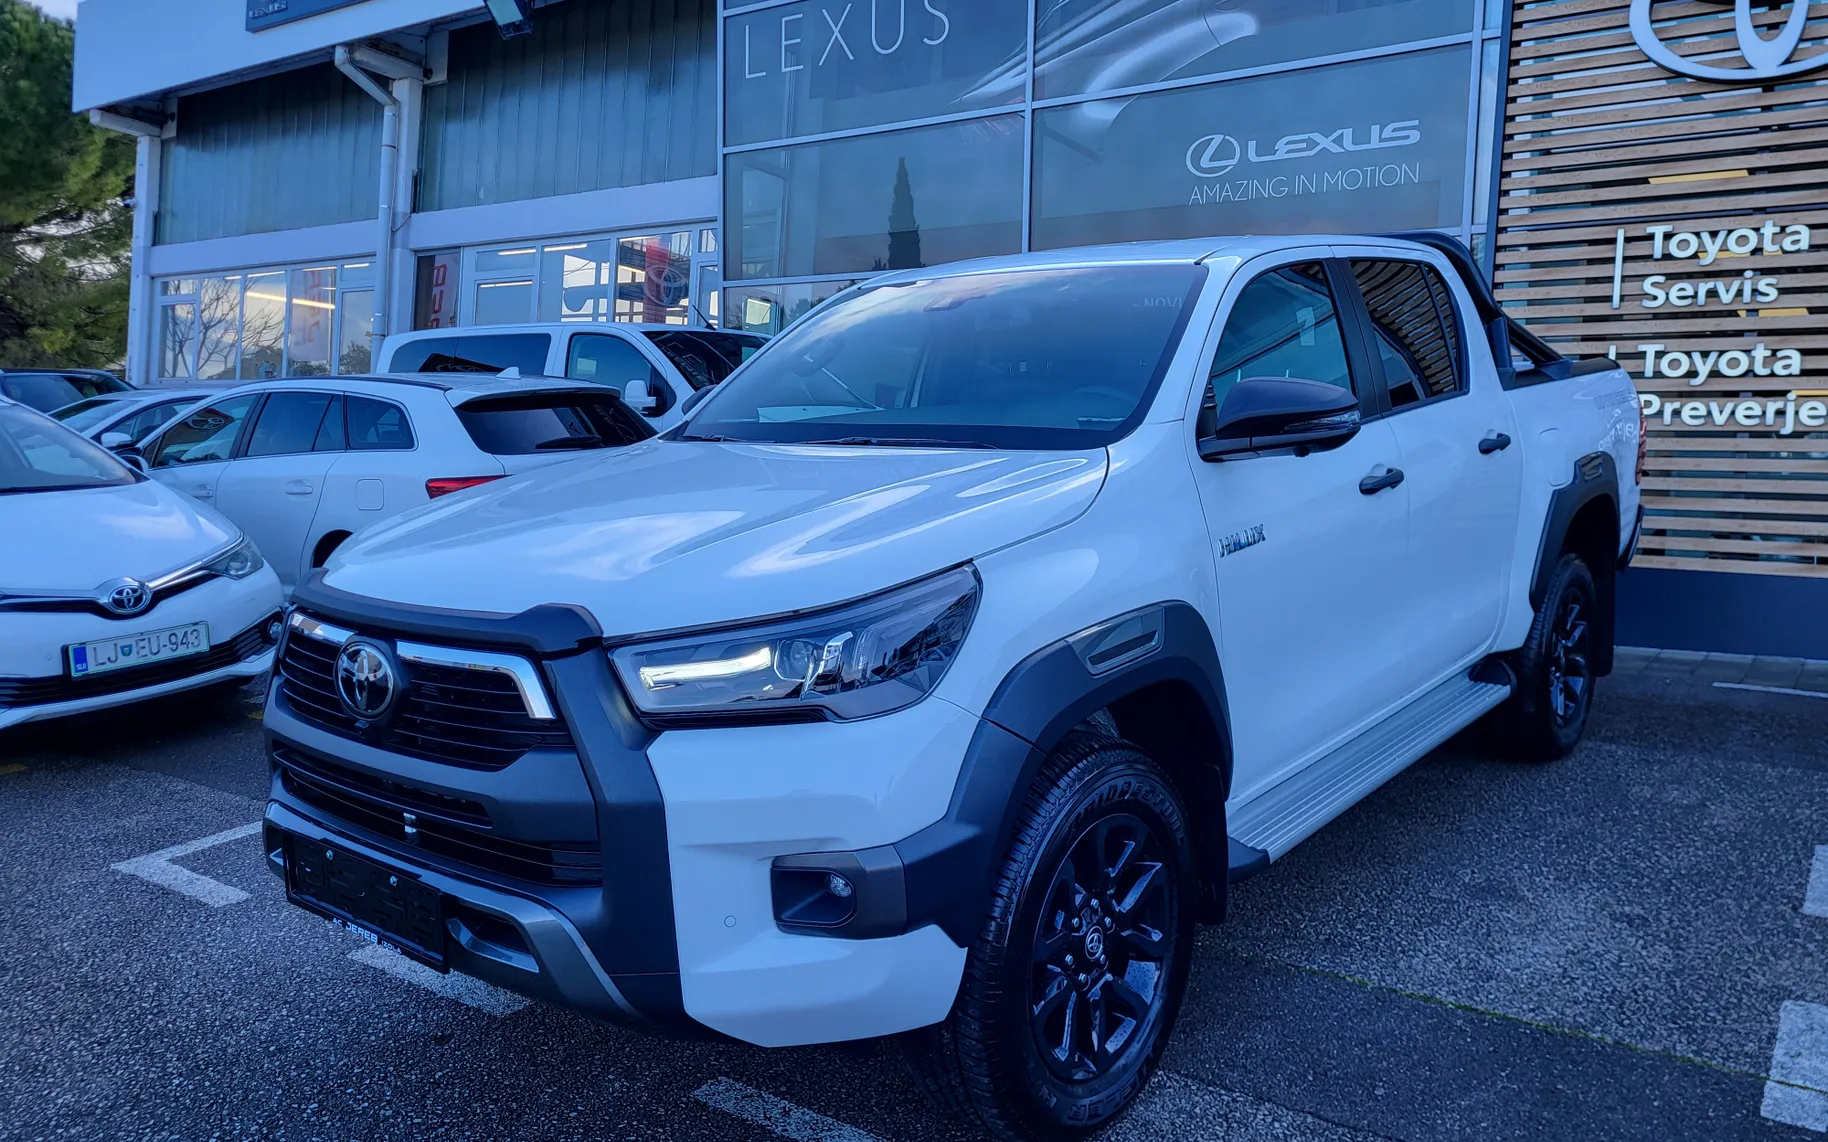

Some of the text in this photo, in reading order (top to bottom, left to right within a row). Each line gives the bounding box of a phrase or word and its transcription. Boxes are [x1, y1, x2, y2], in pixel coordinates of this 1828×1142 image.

[745, 0, 950, 79] LEXUS
[1247, 119, 1421, 163] LEXUS
[1188, 161, 1421, 206] AMAZING IN MOTION
[1645, 219, 1811, 267] Toyota
[1640, 269, 1780, 309] Servis
[1637, 342, 1802, 387] Toyota
[1637, 391, 1828, 436] Preverje
[1217, 523, 1267, 558] HILUX
[92, 628, 201, 667] LJ EU-943
[345, 921, 379, 945] JEREB
[381, 939, 402, 954] IZOLA
